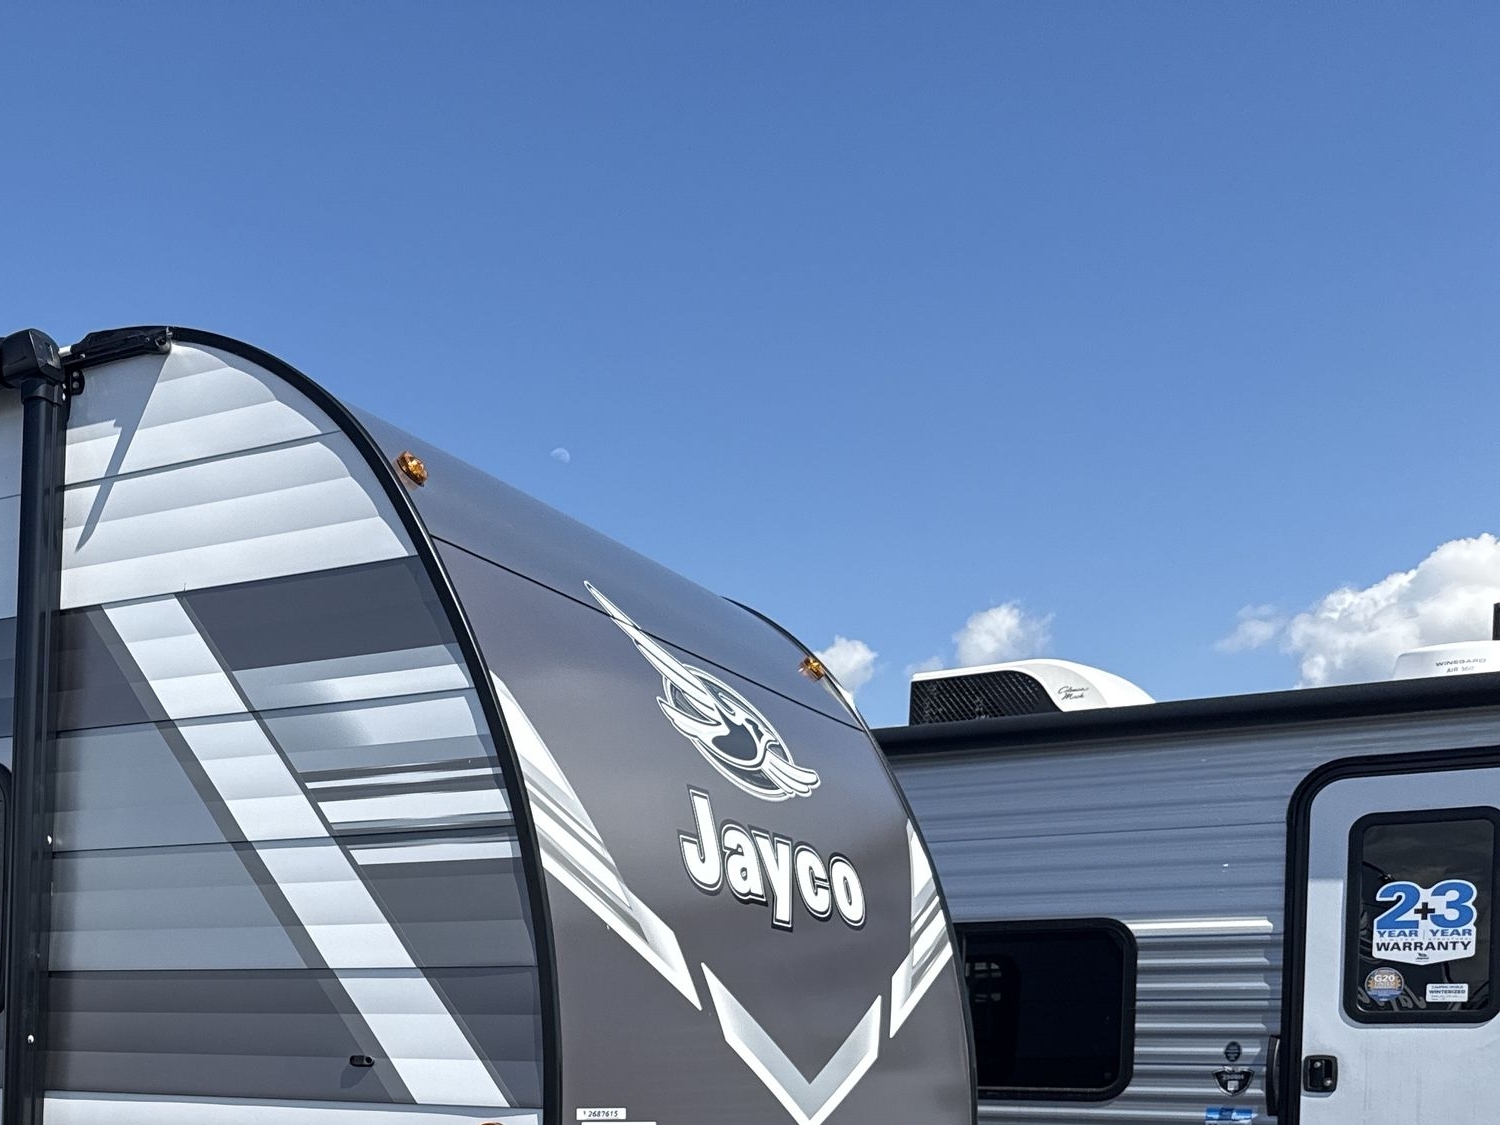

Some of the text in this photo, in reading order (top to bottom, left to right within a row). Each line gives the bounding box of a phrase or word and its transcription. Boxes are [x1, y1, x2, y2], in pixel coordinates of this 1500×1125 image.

[1435, 658, 1486, 667] WINEGARD
[677, 784, 867, 932] Jayco
[1376, 929, 1473, 938] YEAR YEAR
[1376, 941, 1472, 952] WARRANTY
[1373, 974, 1396, 982] G20
